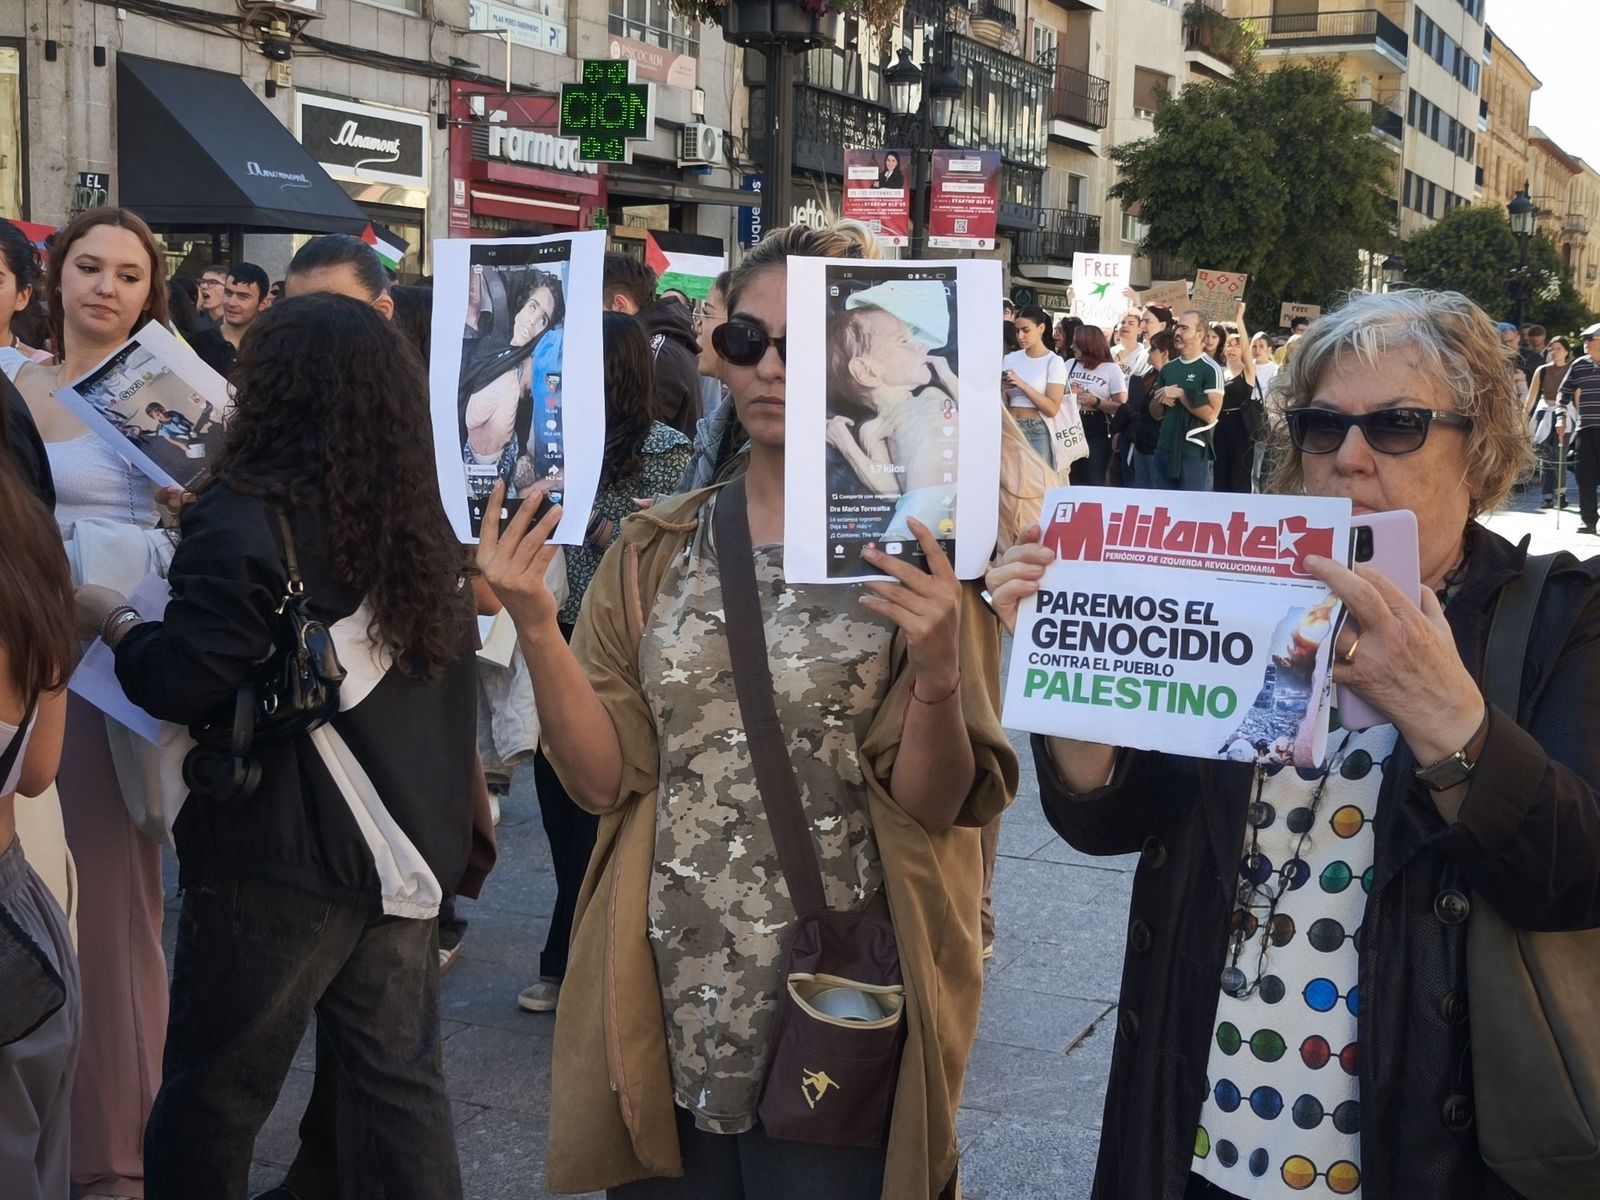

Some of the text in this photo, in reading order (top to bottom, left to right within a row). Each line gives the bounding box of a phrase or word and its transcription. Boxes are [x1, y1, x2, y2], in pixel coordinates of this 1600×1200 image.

[86, 174, 102, 188] EL
[1084, 258, 1119, 277] FREE
[119, 378, 145, 401] Gaza
[1043, 502, 1278, 562] Militante
[1105, 551, 1275, 575] PERIÓDICO DE IZQUIERDA REVOLUCIONARIA
[1036, 590, 1219, 626] PAREMOS EL
[1031, 617, 1254, 666] GENOCIDIO
[1028, 652, 1174, 677] CONTRA EL PUEBLO
[1023, 668, 1238, 719] PALESTINO
